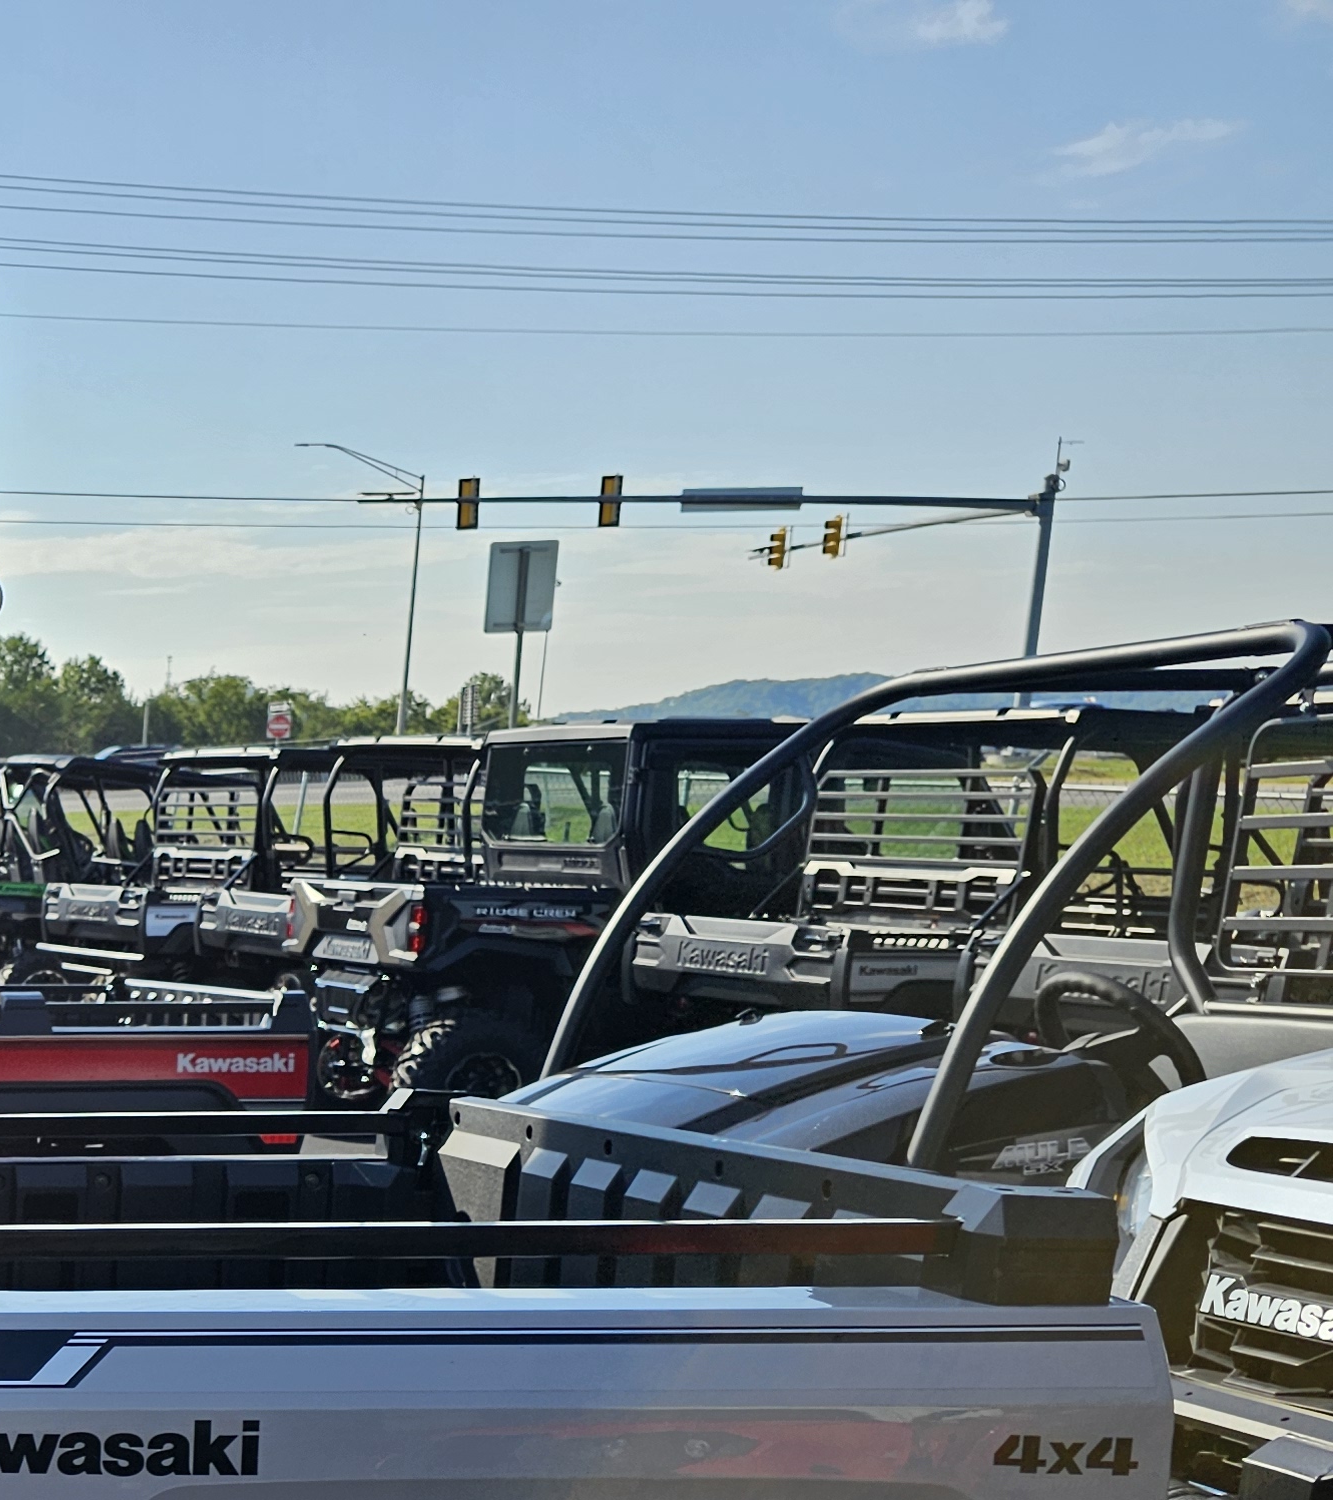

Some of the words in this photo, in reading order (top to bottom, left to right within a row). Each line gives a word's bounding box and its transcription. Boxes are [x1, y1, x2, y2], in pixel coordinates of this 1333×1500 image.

[676, 940, 770, 976] Kawasaki
[858, 964, 919, 977] Kawasaki
[176, 1052, 296, 1073] Kawasaki
[992, 1137, 1093, 1169] MULE
[993, 1434, 1139, 1477] 4x4
